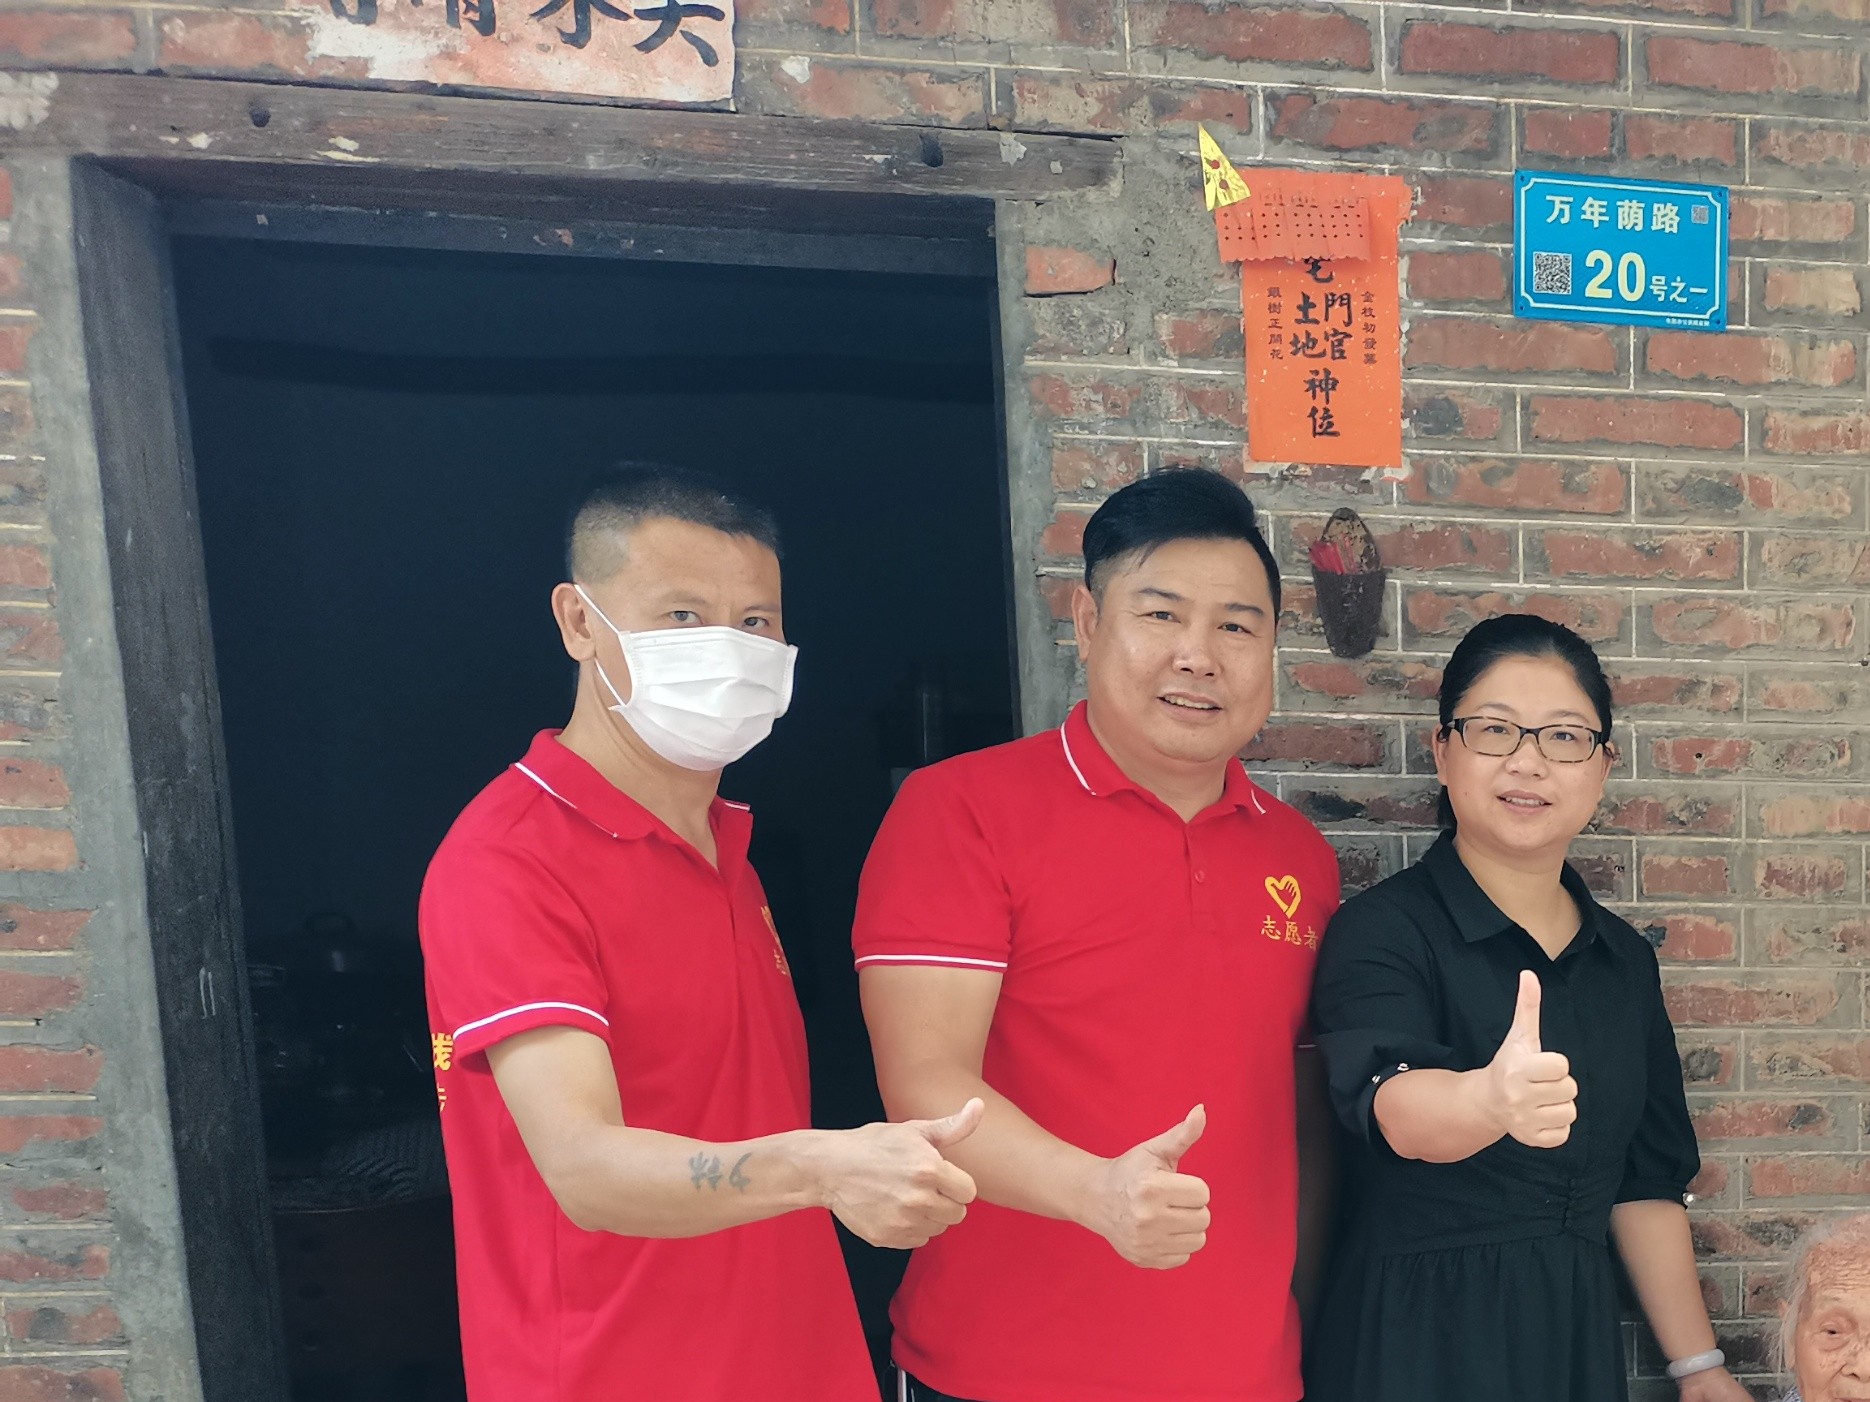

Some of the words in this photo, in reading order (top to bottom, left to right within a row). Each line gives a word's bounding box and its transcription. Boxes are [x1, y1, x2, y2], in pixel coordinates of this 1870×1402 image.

[1545, 194, 1680, 234] 万年荫路
[1260, 914, 1319, 952] 志愿者
